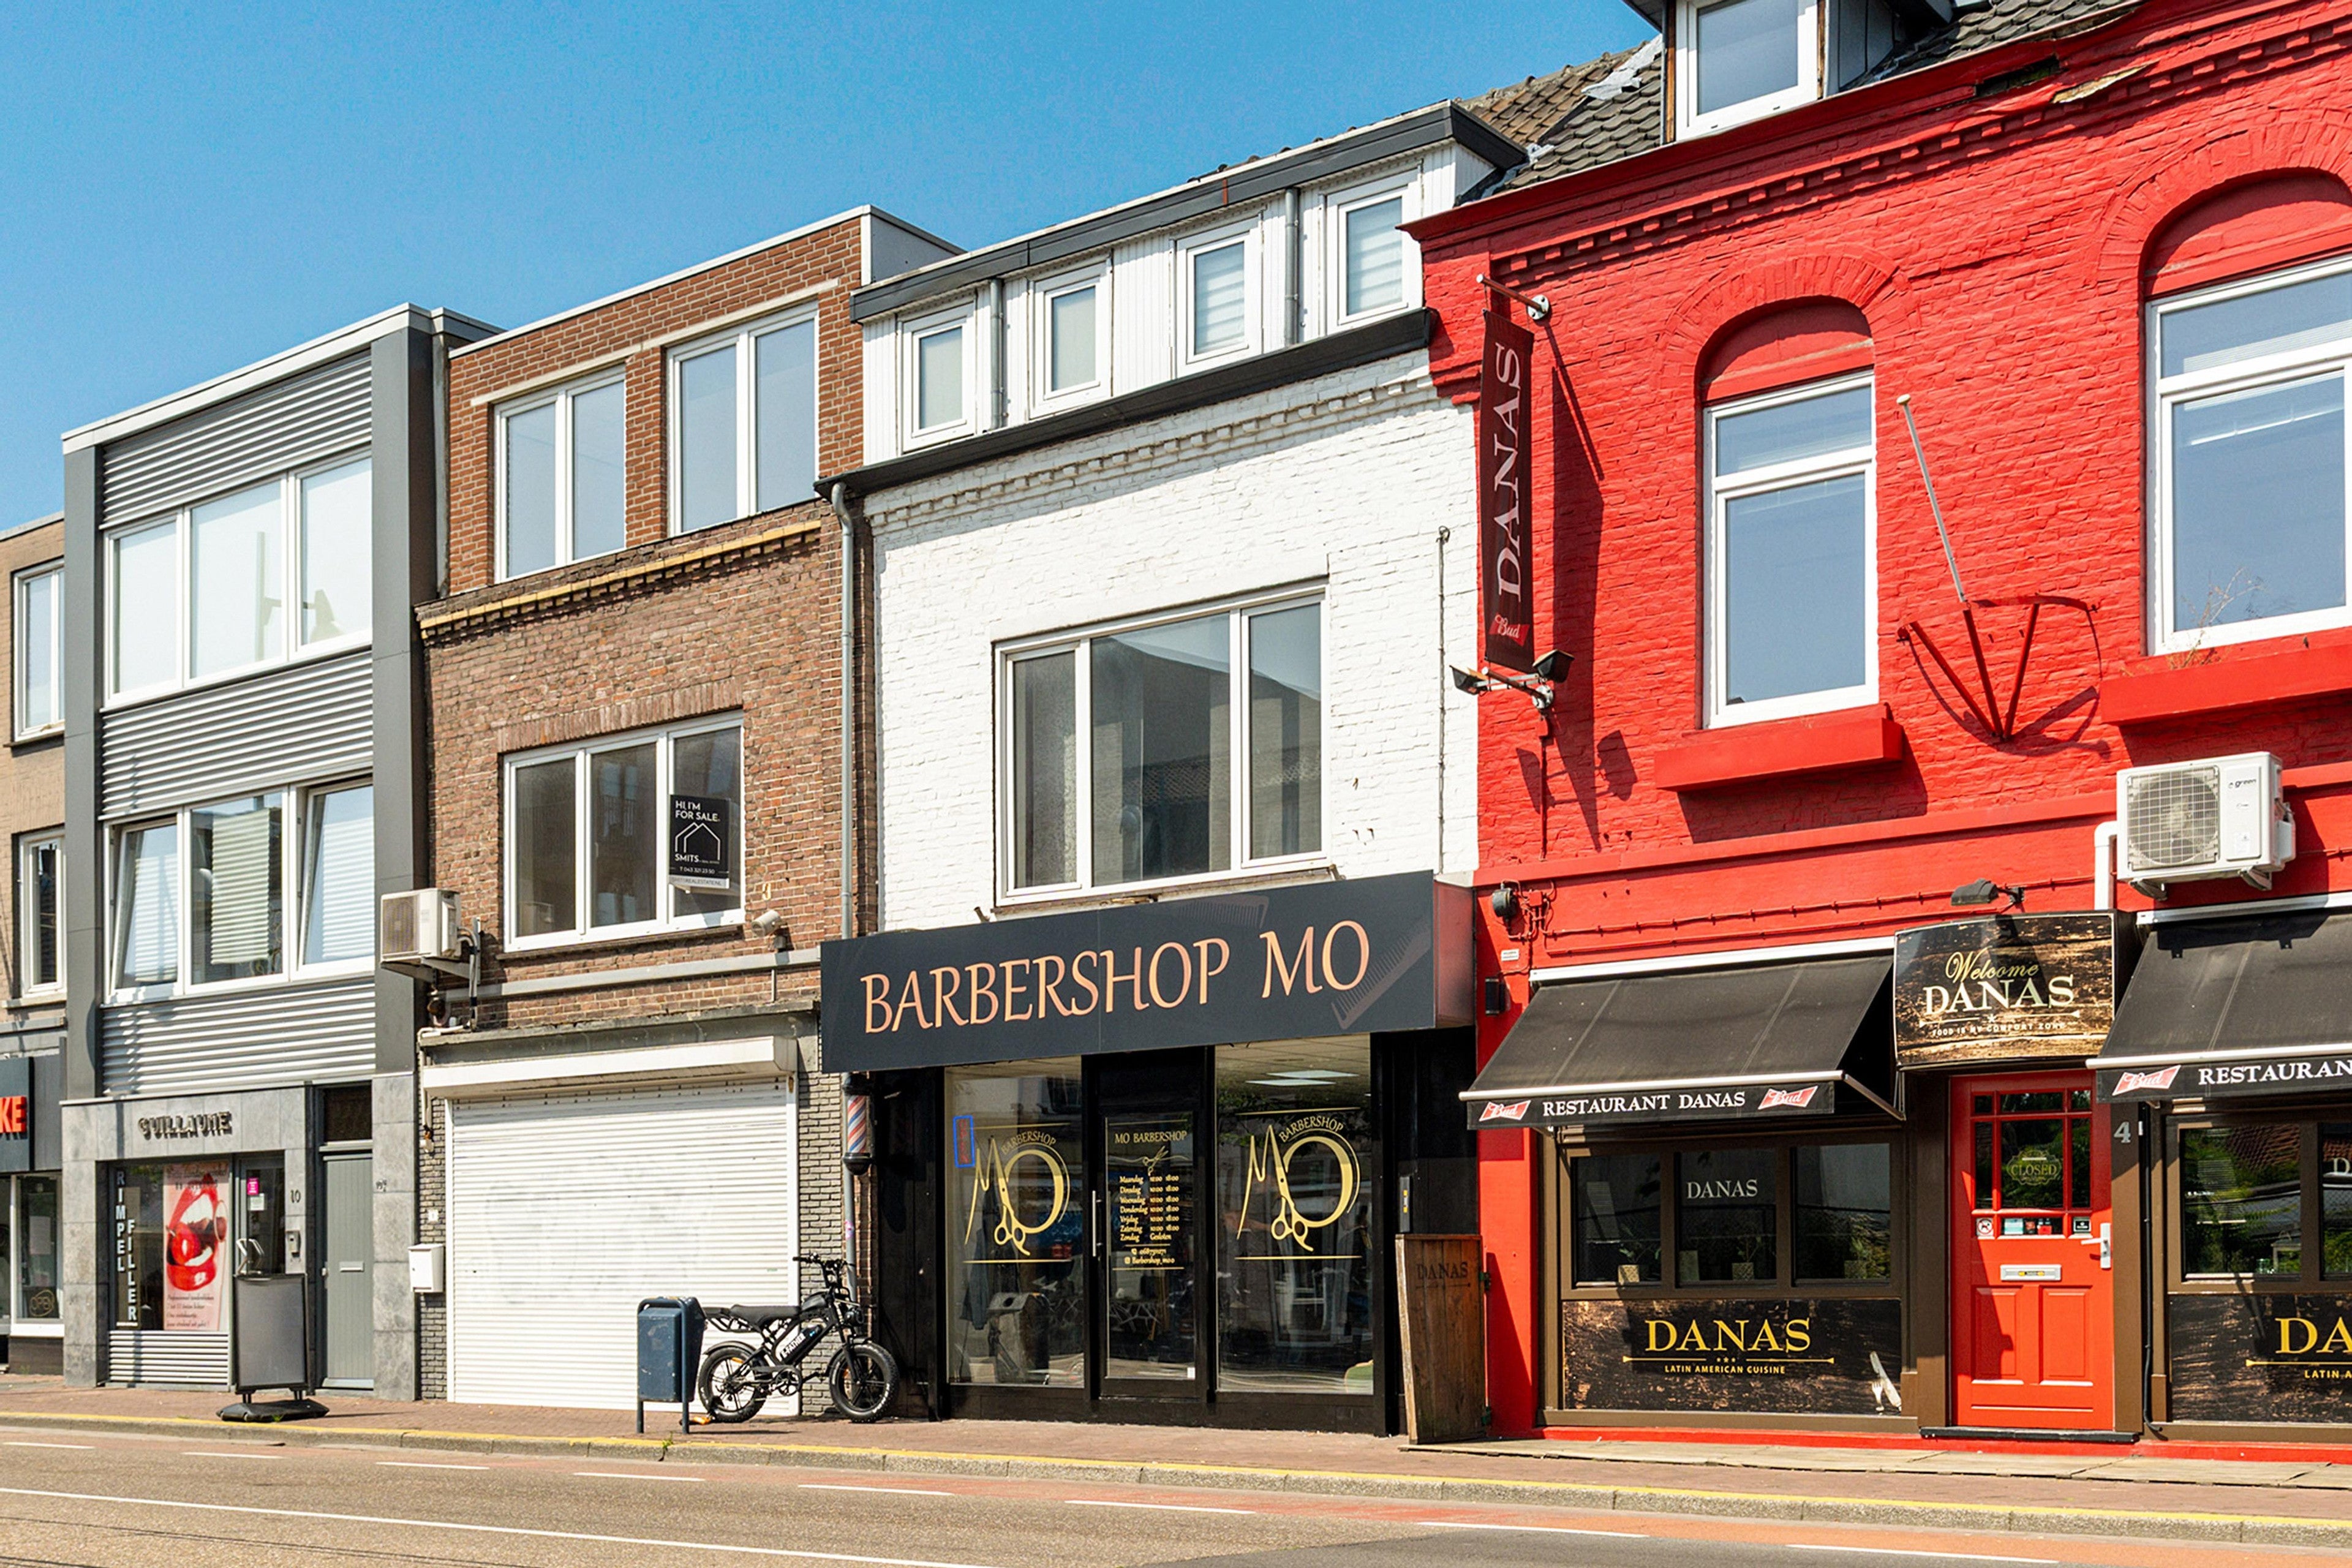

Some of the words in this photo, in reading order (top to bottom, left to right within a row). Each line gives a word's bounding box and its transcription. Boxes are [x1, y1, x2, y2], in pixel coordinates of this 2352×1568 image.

[1493, 342, 1521, 603] DANAS
[1494, 614, 1520, 638] Bud
[676, 810, 694, 820] FOR
[1946, 946, 2038, 982] Welcome
[861, 938, 1229, 1033] BARBERSHOP
[1259, 921, 1370, 998] MO
[1923, 974, 2075, 1015] DANAS
[1932, 1028, 1954, 1036] FOOD
[1986, 1023, 2033, 1032] COMFORT
[2198, 1060, 2352, 1085] RESTAURAN
[0, 1096, 26, 1134] KE
[1543, 1095, 1670, 1117] RESTAURANT
[1678, 1091, 1745, 1109] DANAS
[138, 1111, 232, 1137] GUILLAUME
[1279, 1116, 1344, 1142] BARBERSHOP
[2114, 1121, 2131, 1144] 4
[1001, 1131, 1057, 1155] BARBERSHOP
[1115, 1133, 1130, 1144] MO
[1133, 1130, 1187, 1143] BARBERSHOP
[2011, 1164, 2057, 1176] CLOSED
[290, 1189, 301, 1203] 10
[1120, 1185, 1141, 1195] Dinsdag
[1120, 1196, 1145, 1205] Woensdag
[1687, 1179, 1757, 1199] DANAS
[116, 1171, 126, 1272] RIMPEL
[1120, 1205, 1148, 1215] Donderdag
[1120, 1215, 1139, 1225] Vrijdag
[1120, 1224, 1142, 1234] Zaterdag
[1120, 1233, 1140, 1243] Zondag
[127, 1219, 137, 1321] FILLER
[1416, 1262, 1468, 1280] DANAS
[1645, 1317, 1811, 1353] DANAS
[2275, 1317, 2352, 1354] DA
[1665, 1365, 1691, 1373] LATIN
[1695, 1365, 1743, 1374] AMERICAN
[1747, 1366, 1785, 1374] CUISINE
[2304, 1370, 2339, 1378] LATIN
